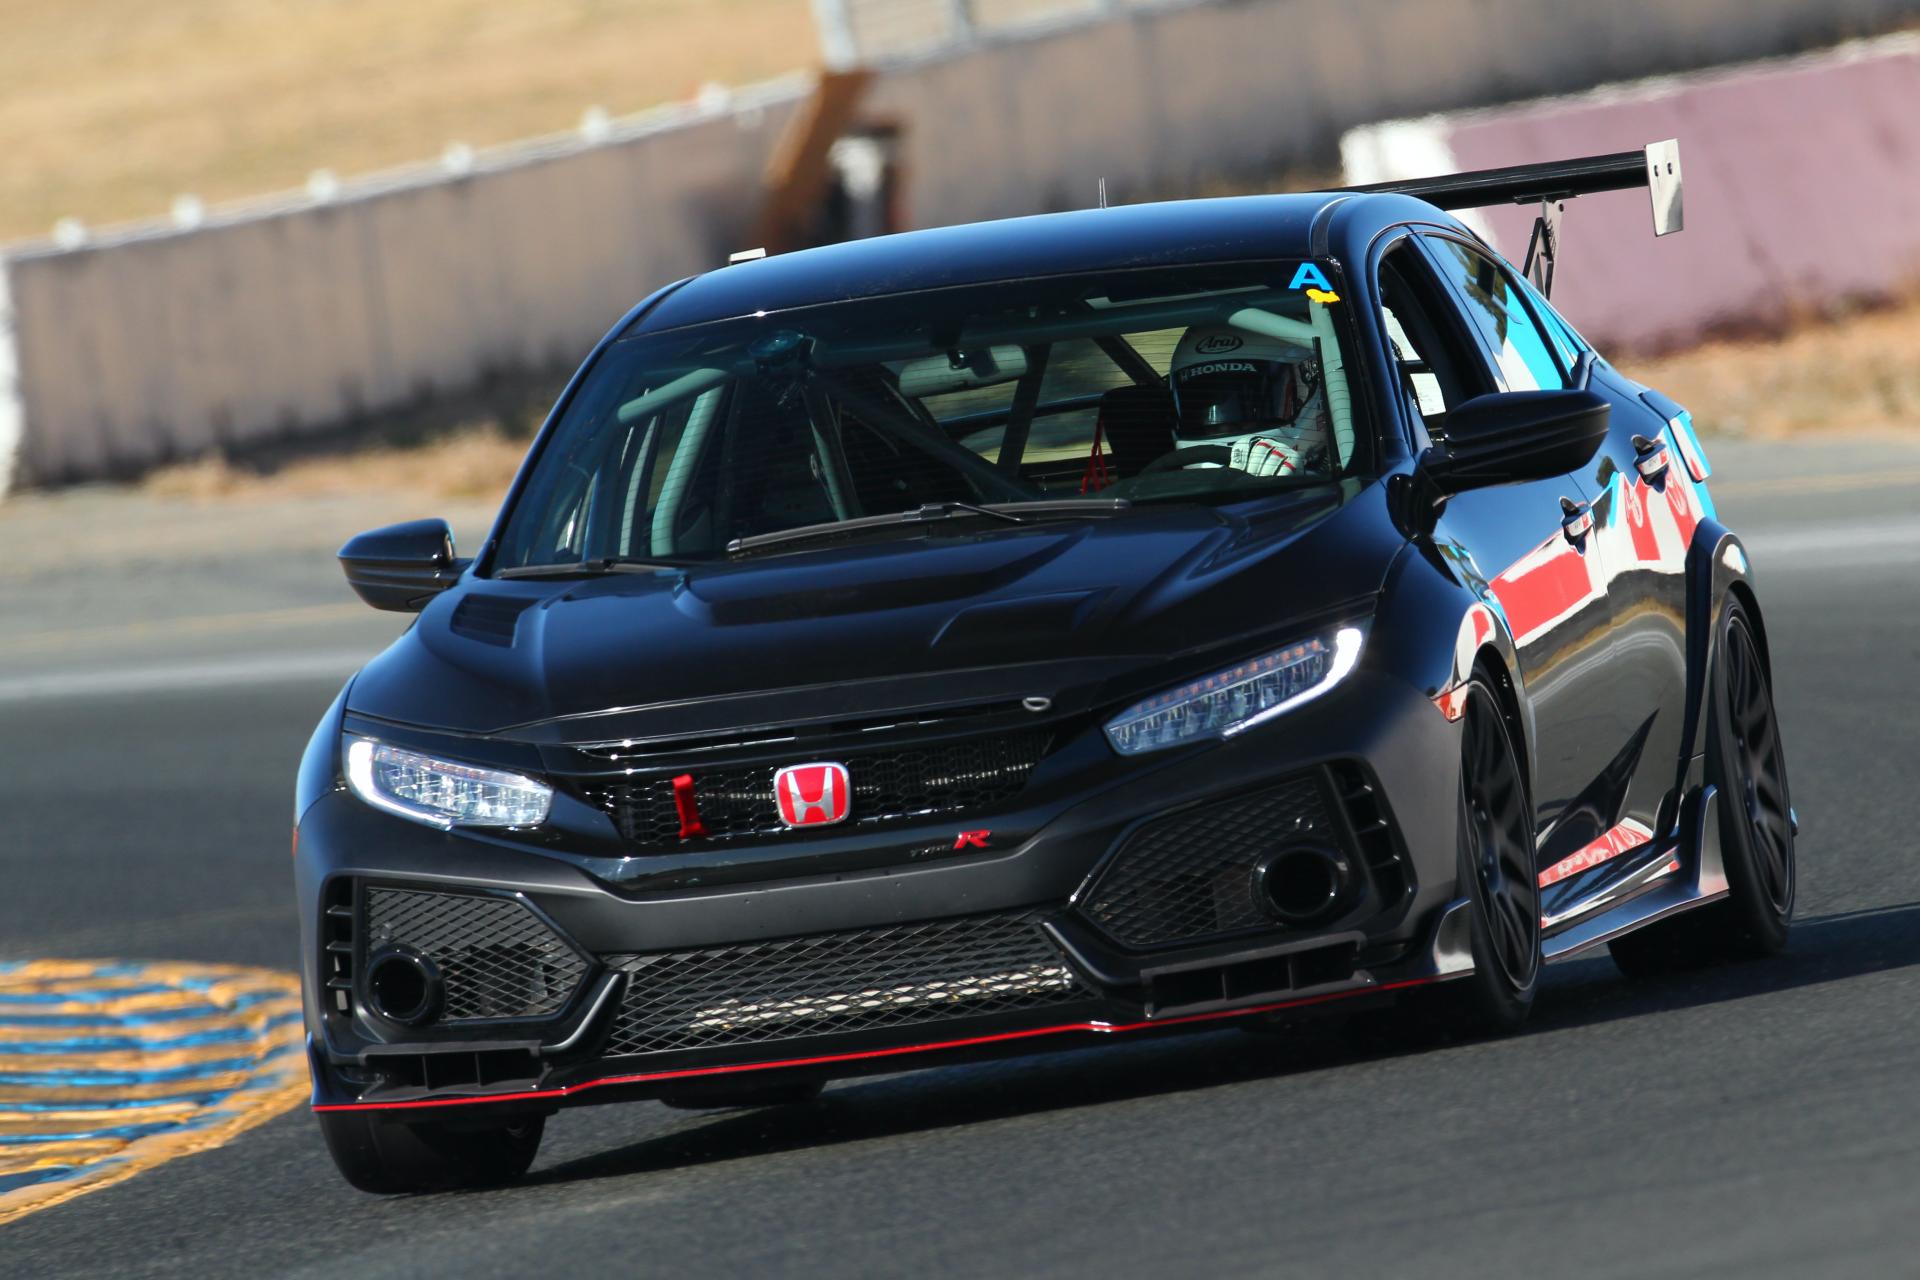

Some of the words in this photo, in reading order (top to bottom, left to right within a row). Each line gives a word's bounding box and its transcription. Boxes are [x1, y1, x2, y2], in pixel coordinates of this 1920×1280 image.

[1288, 262, 1334, 291] A
[1200, 335, 1238, 350] Arai
[1190, 362, 1257, 377] HONDA
[953, 829, 992, 849] R
